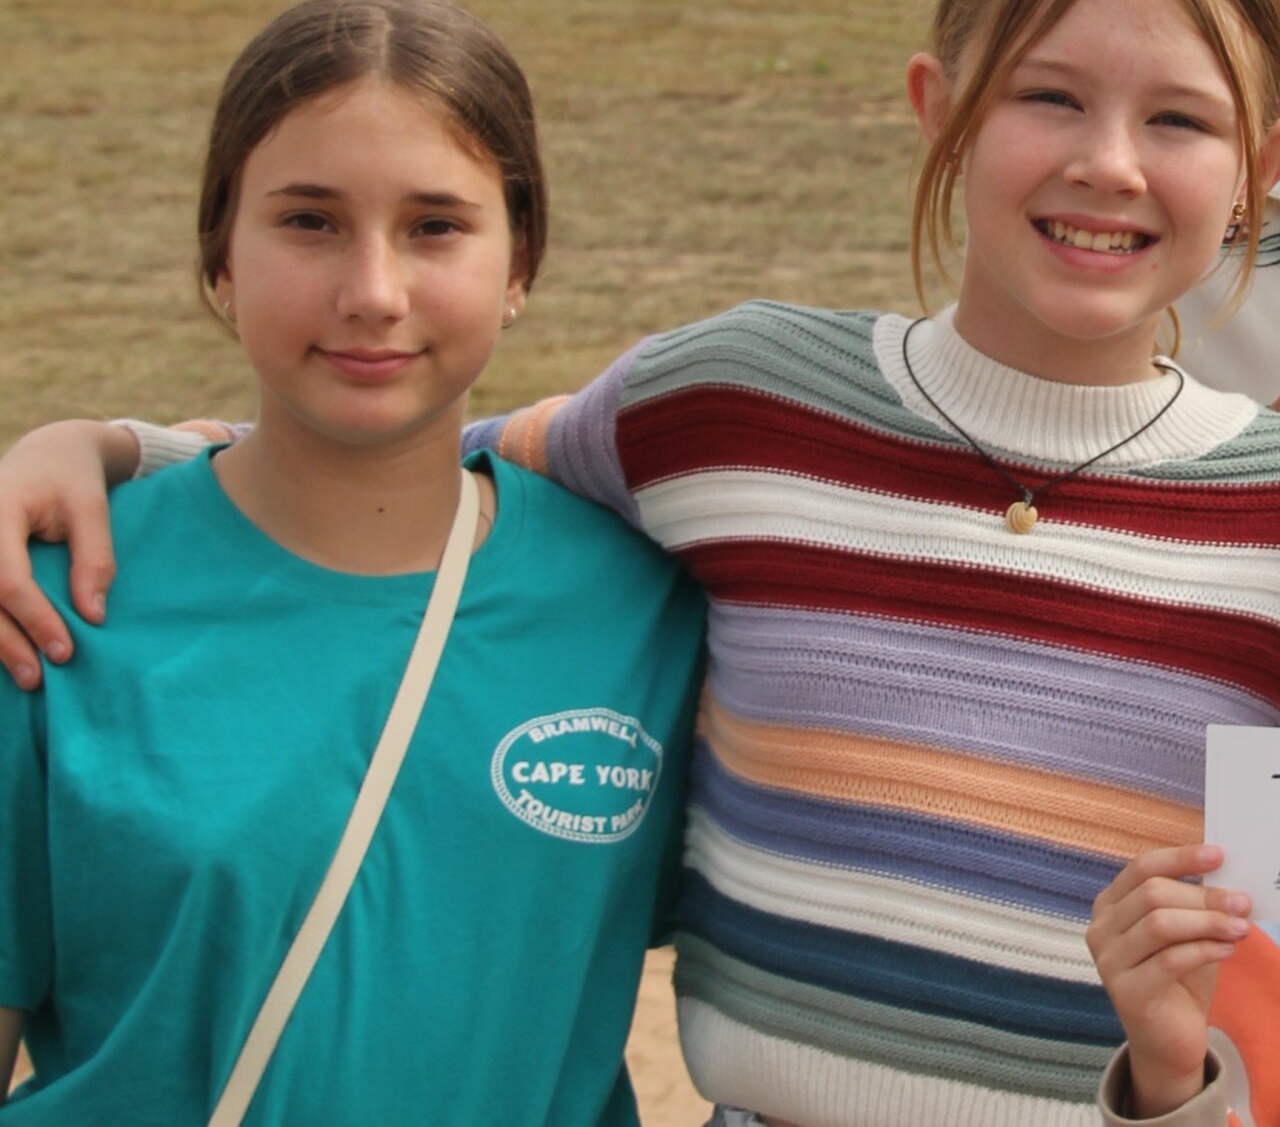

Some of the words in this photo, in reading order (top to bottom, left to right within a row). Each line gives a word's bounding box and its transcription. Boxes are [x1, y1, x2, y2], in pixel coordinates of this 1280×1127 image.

[511, 761, 586, 784] CAPE
[595, 764, 654, 791] YORK
[514, 788, 608, 833] TOURIST
